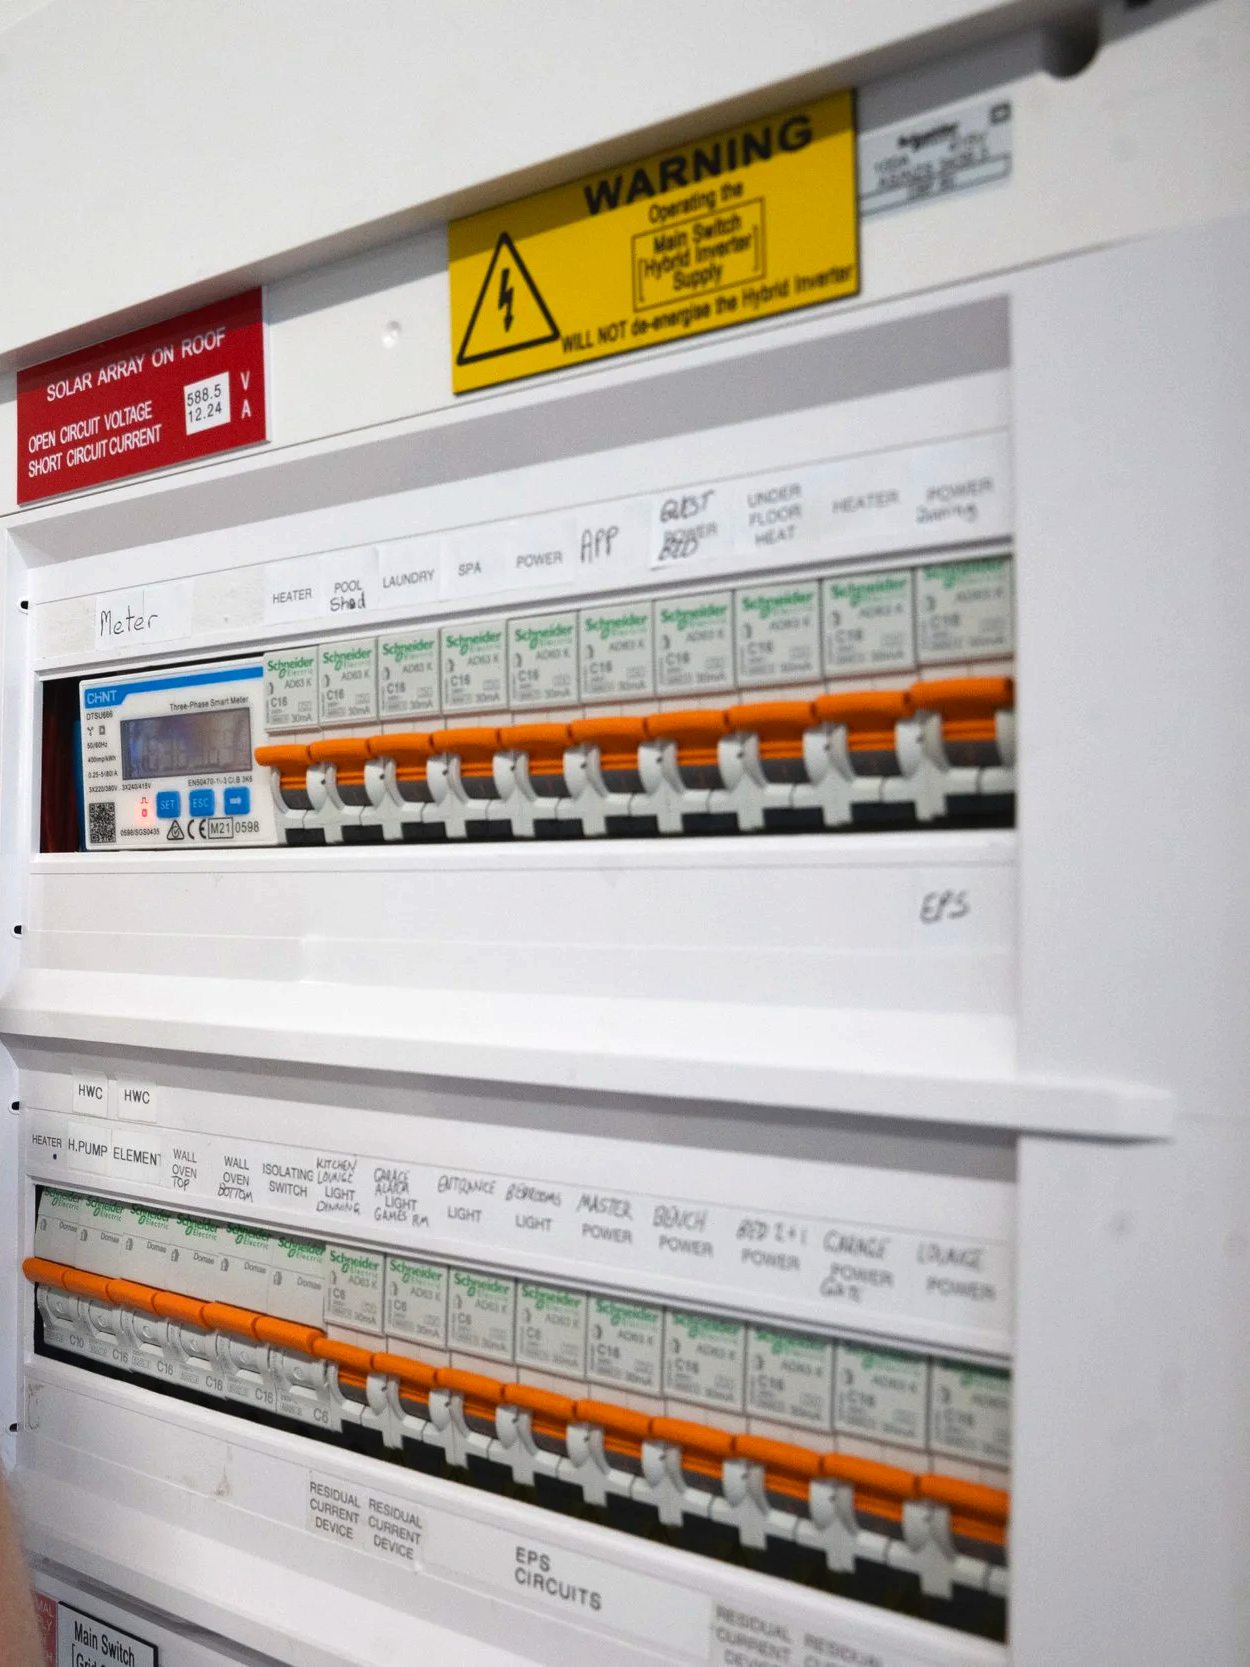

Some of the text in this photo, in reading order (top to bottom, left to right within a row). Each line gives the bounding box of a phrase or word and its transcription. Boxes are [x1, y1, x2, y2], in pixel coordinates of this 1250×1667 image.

[584, 115, 814, 215] WARNING
[648, 180, 745, 224] Operating the
[653, 213, 742, 254] Main Switch
[644, 234, 752, 280] Hybrid Inverter
[672, 264, 724, 292] Supply
[561, 265, 852, 355] WILL NOT de-energise the Hybrid Inverter
[46, 327, 227, 402] SOLAR ARRAY ON ROOF
[240, 371, 250, 390] V
[187, 385, 222, 407] 588.5
[188, 403, 222, 424] 12.24
[241, 400, 252, 419] A
[29, 401, 153, 453] OPEN CIRCUIT VOLTAGE
[29, 425, 162, 478] SHORT CIRCUIT CURRENT
[747, 483, 801, 508] UNDER
[832, 489, 900, 513] HEATER
[749, 504, 802, 526] FLOOR
[581, 526, 619, 563] APP
[755, 526, 796, 545] HEAT
[458, 561, 482, 577] SPA
[516, 551, 563, 569] POWER
[334, 580, 363, 594] POOL
[382, 569, 435, 589] LAUNDRY
[272, 587, 313, 605] HEATER
[100, 610, 159, 637] Meter
[323, 648, 372, 671] Schneider
[382, 639, 435, 662] Schneider
[267, 657, 314, 679] Schneider
[169, 696, 250, 712] Three-Phase Smart Meter
[271, 696, 288, 708] C16
[326, 688, 346, 701] C16
[160, 800, 175, 810] SET
[192, 798, 209, 808] ESC
[210, 823, 230, 834] M21
[234, 821, 260, 834] 0598
[78, 1084, 103, 1100] HWC
[124, 1089, 150, 1105] HWC
[32, 1134, 62, 1149] HEATER
[68, 1138, 108, 1158] H.PUMP
[173, 1148, 198, 1164] WALL
[224, 1155, 249, 1171] WALL
[172, 1164, 198, 1180] OVEN
[222, 1171, 250, 1186] OVEN
[262, 1163, 314, 1182] ISOLATING
[171, 1175, 191, 1191] TOP
[269, 1180, 308, 1198] SWITCH
[217, 1186, 253, 1202] BOTTOM
[325, 1186, 356, 1201] LIGHT
[385, 1196, 417, 1212] LIGHT
[374, 1207, 408, 1223] GAMES
[447, 1205, 483, 1224] LIGHT
[515, 1213, 553, 1232] LIGHT
[582, 1222, 633, 1244] POWER
[658, 1235, 714, 1259] POWER
[330, 1251, 379, 1273] Schneider
[741, 1247, 800, 1272] POWER
[390, 1259, 443, 1283] Schneider
[830, 1261, 894, 1288] POWER
[69, 1335, 85, 1348] C10
[112, 1349, 129, 1363] C16
[157, 1361, 174, 1376] C16
[205, 1376, 223, 1391] C16
[255, 1388, 274, 1405] C16
[309, 1480, 362, 1509] RESIDUAL
[309, 1499, 360, 1525] CURRENT
[369, 1498, 423, 1529] RESIDUAL
[315, 1516, 354, 1540] DEVICE
[368, 1516, 421, 1545] CURRENT
[373, 1534, 414, 1560] DEVICE
[515, 1545, 551, 1573] EPS
[514, 1566, 603, 1612] CIRCUITS
[74, 1620, 99, 1651] Main
[101, 1634, 136, 1667] Switch
